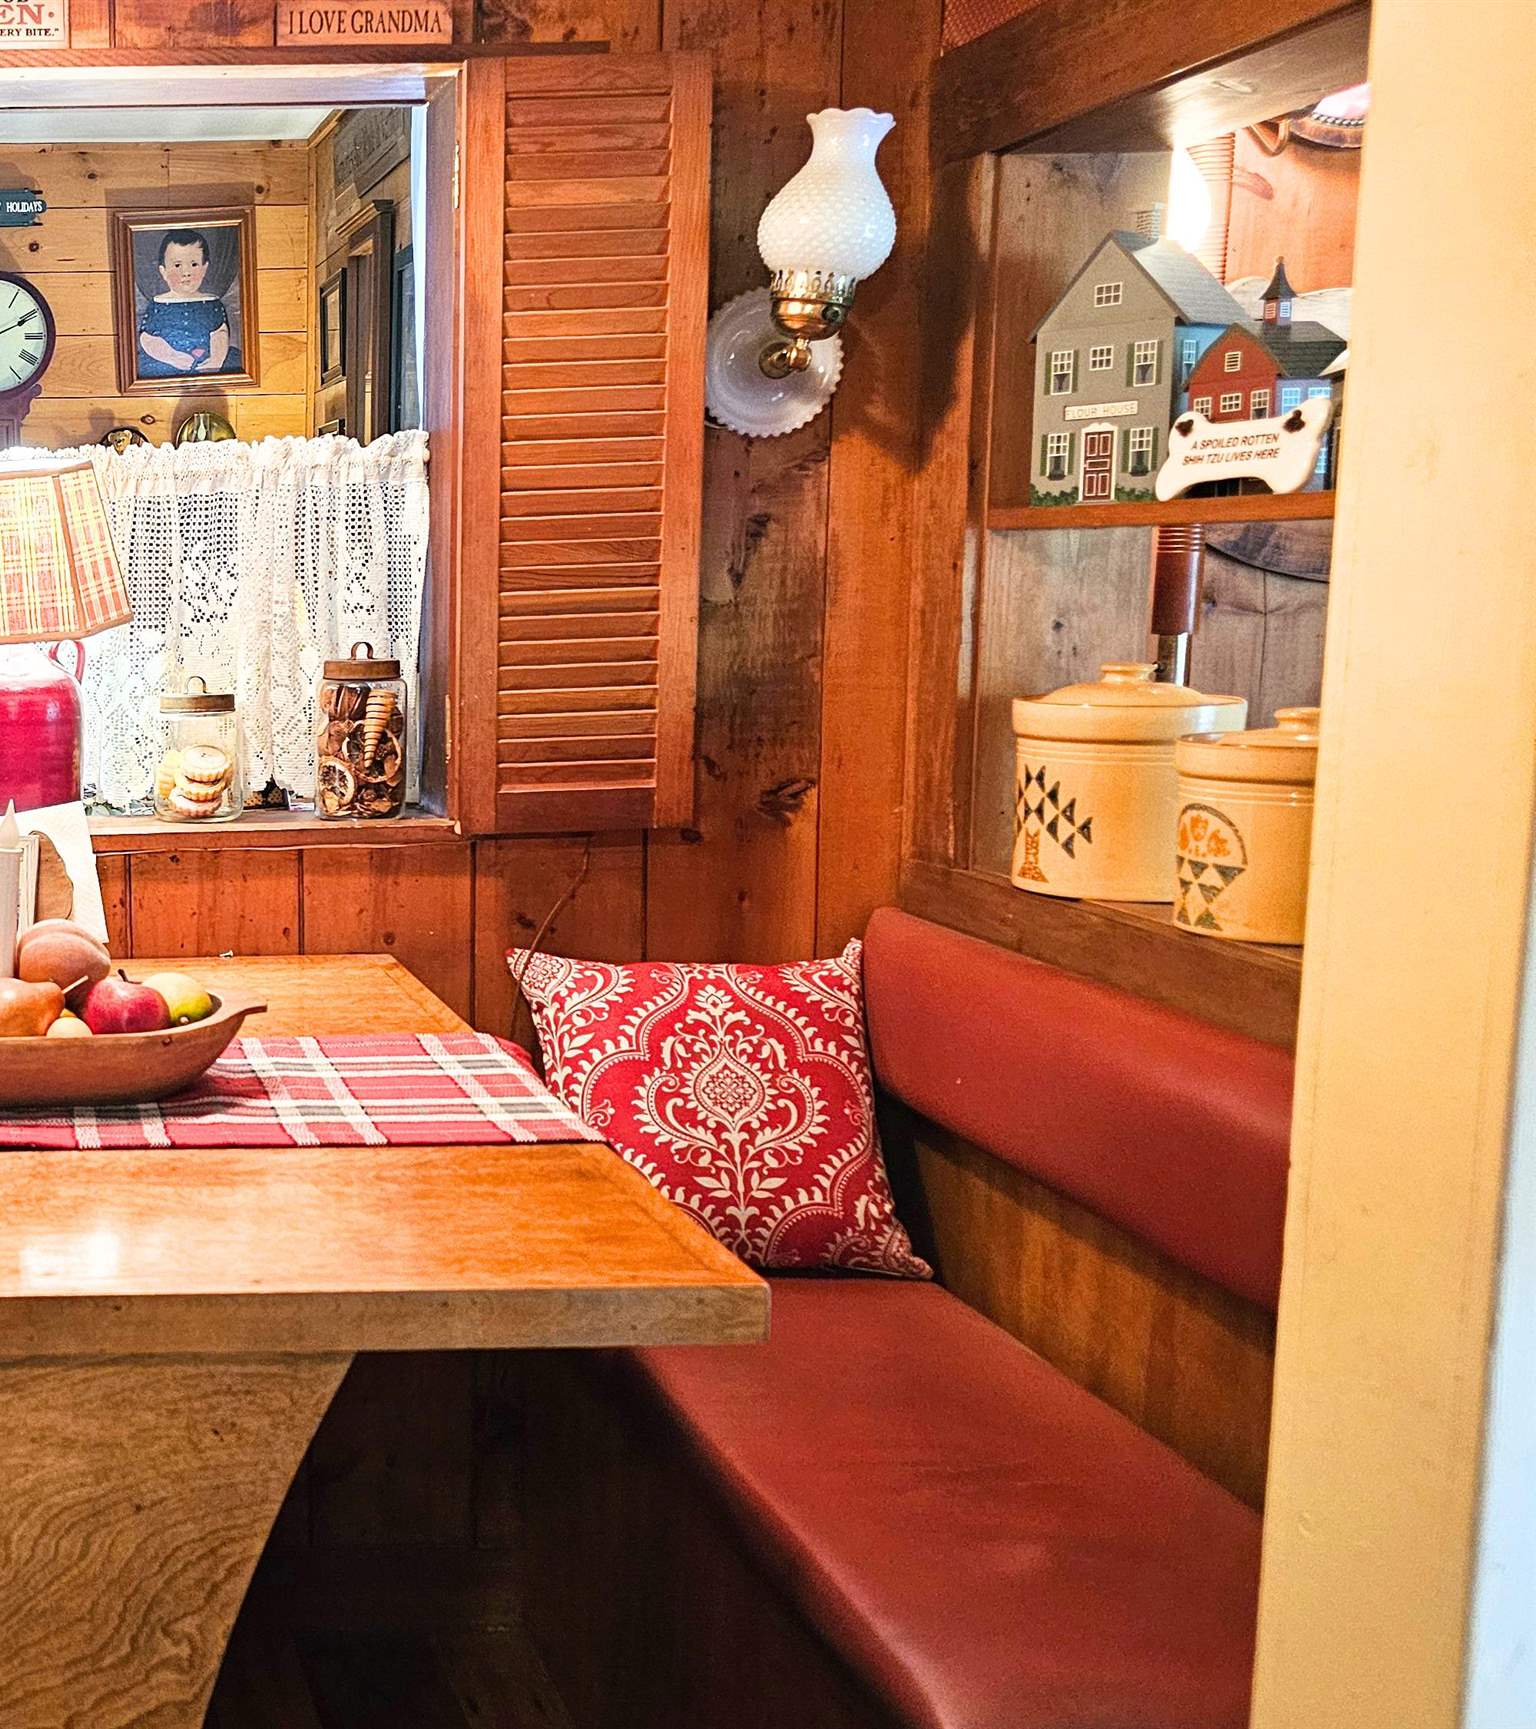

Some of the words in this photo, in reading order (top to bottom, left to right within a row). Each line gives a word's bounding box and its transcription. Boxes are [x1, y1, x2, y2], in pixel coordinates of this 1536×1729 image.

[289, 11, 294, 34] I
[299, 10, 346, 34] LOVE
[351, 10, 442, 34] GRANDMA
[6, 201, 43, 213] HOLIDAYS
[1191, 441, 1199, 450] A
[1199, 436, 1239, 450] SPOILED
[1240, 433, 1280, 447] ROTTEN
[1182, 454, 1204, 466] SHIH
[1206, 452, 1225, 464] TZU
[1226, 450, 1253, 463] LIVES
[1254, 448, 1280, 460] HERE
